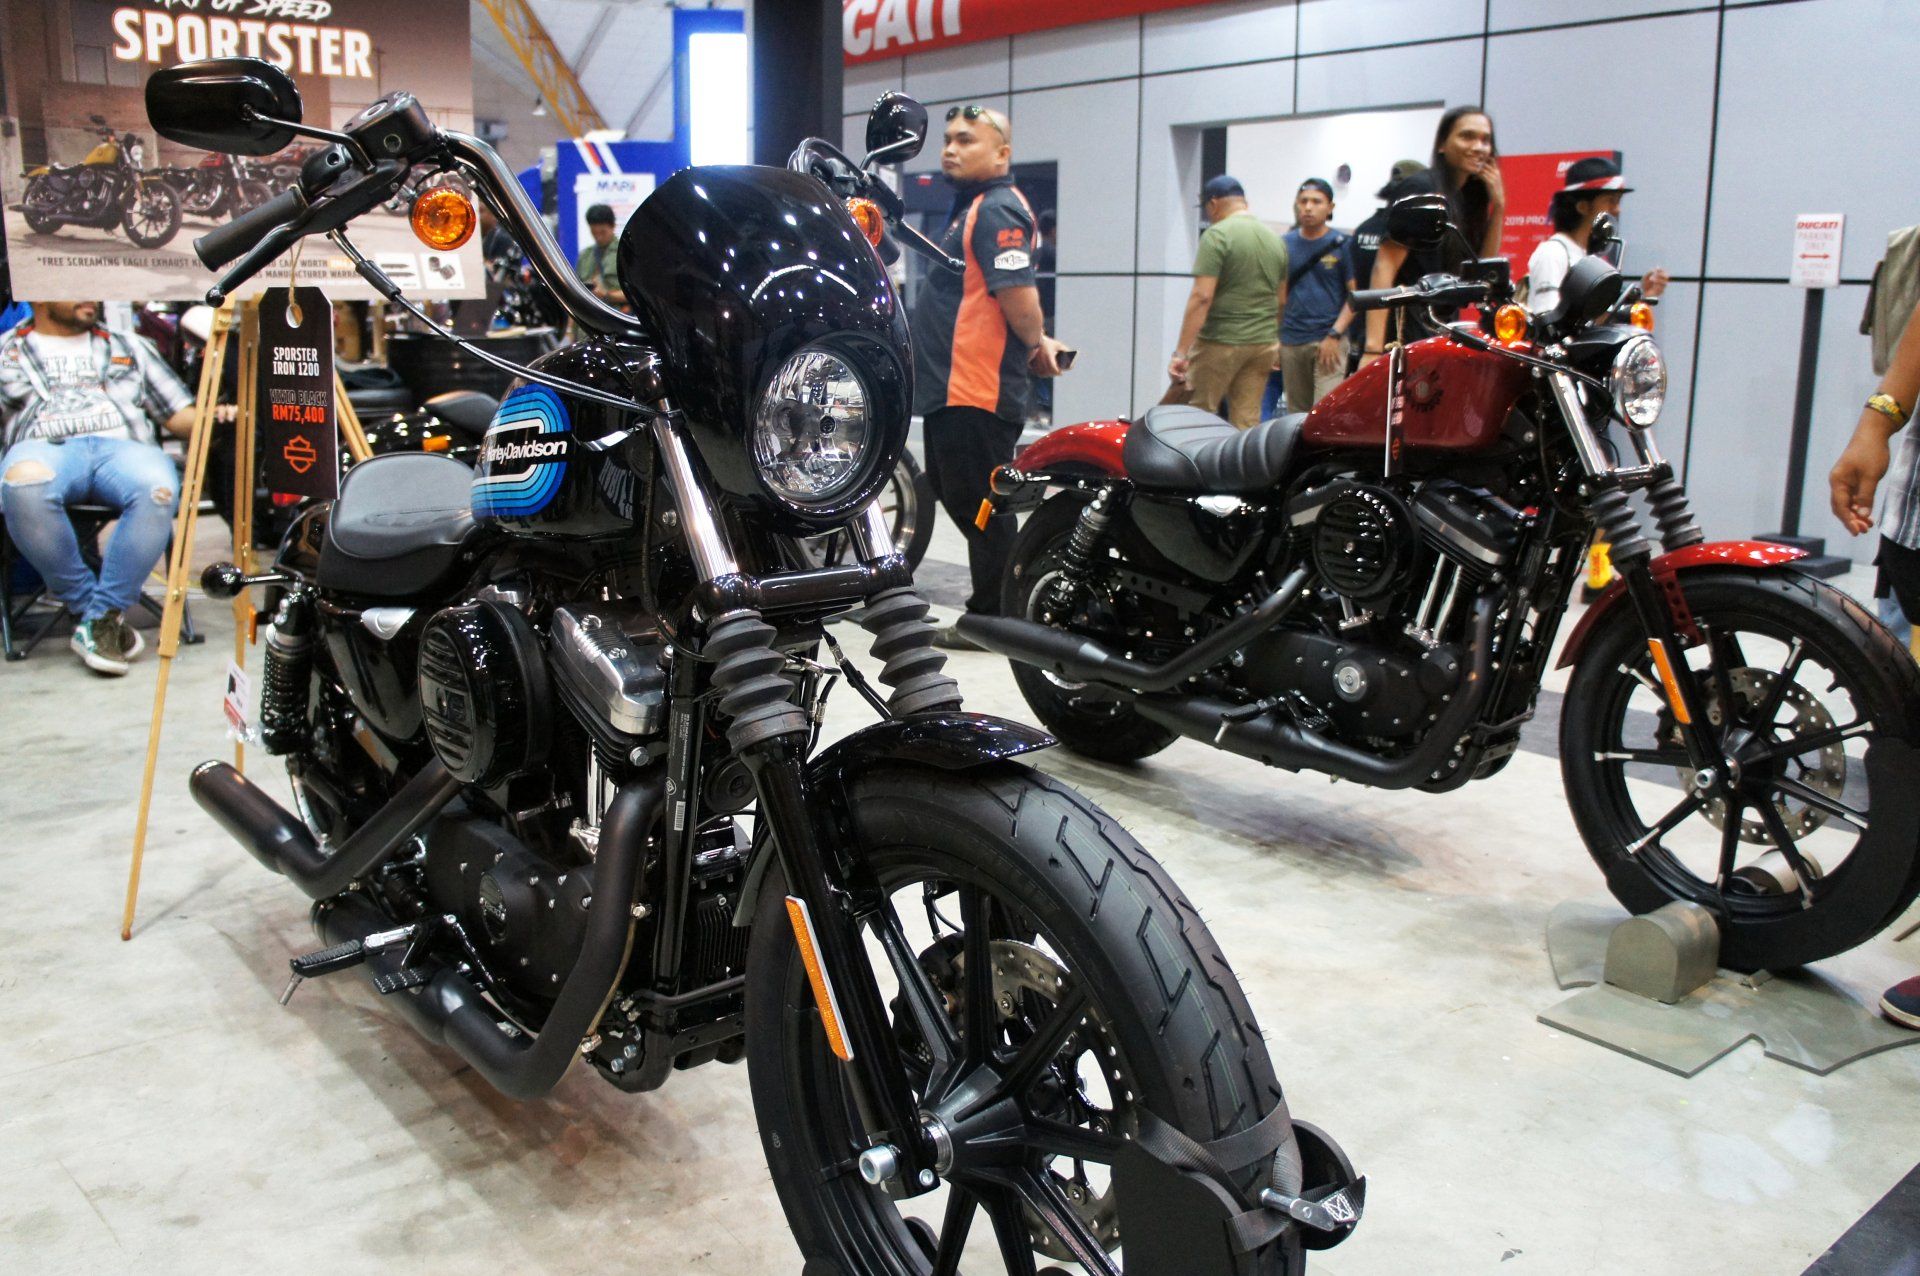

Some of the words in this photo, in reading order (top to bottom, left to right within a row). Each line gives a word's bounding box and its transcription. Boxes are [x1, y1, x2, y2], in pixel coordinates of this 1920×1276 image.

[244, 0, 332, 21] SPEED
[842, 0, 961, 56] CATI
[112, 7, 373, 79] SPORTSTER
[1505, 216, 1525, 226] 2019
[1797, 221, 1838, 230] DUCATI
[66, 257, 120, 267] SCREAMING
[123, 257, 149, 267] EAGLE
[151, 257, 189, 268] EXHAUST
[301, 259, 328, 268] WORTH
[273, 346, 318, 362] SPORSTER
[272, 361, 296, 375] IRON
[298, 361, 320, 377] 1200
[269, 388, 297, 405] VIVID
[298, 390, 328, 407] BLACK
[272, 404, 325, 424] RM75,400
[487, 439, 568, 465] Harley-Davidson
